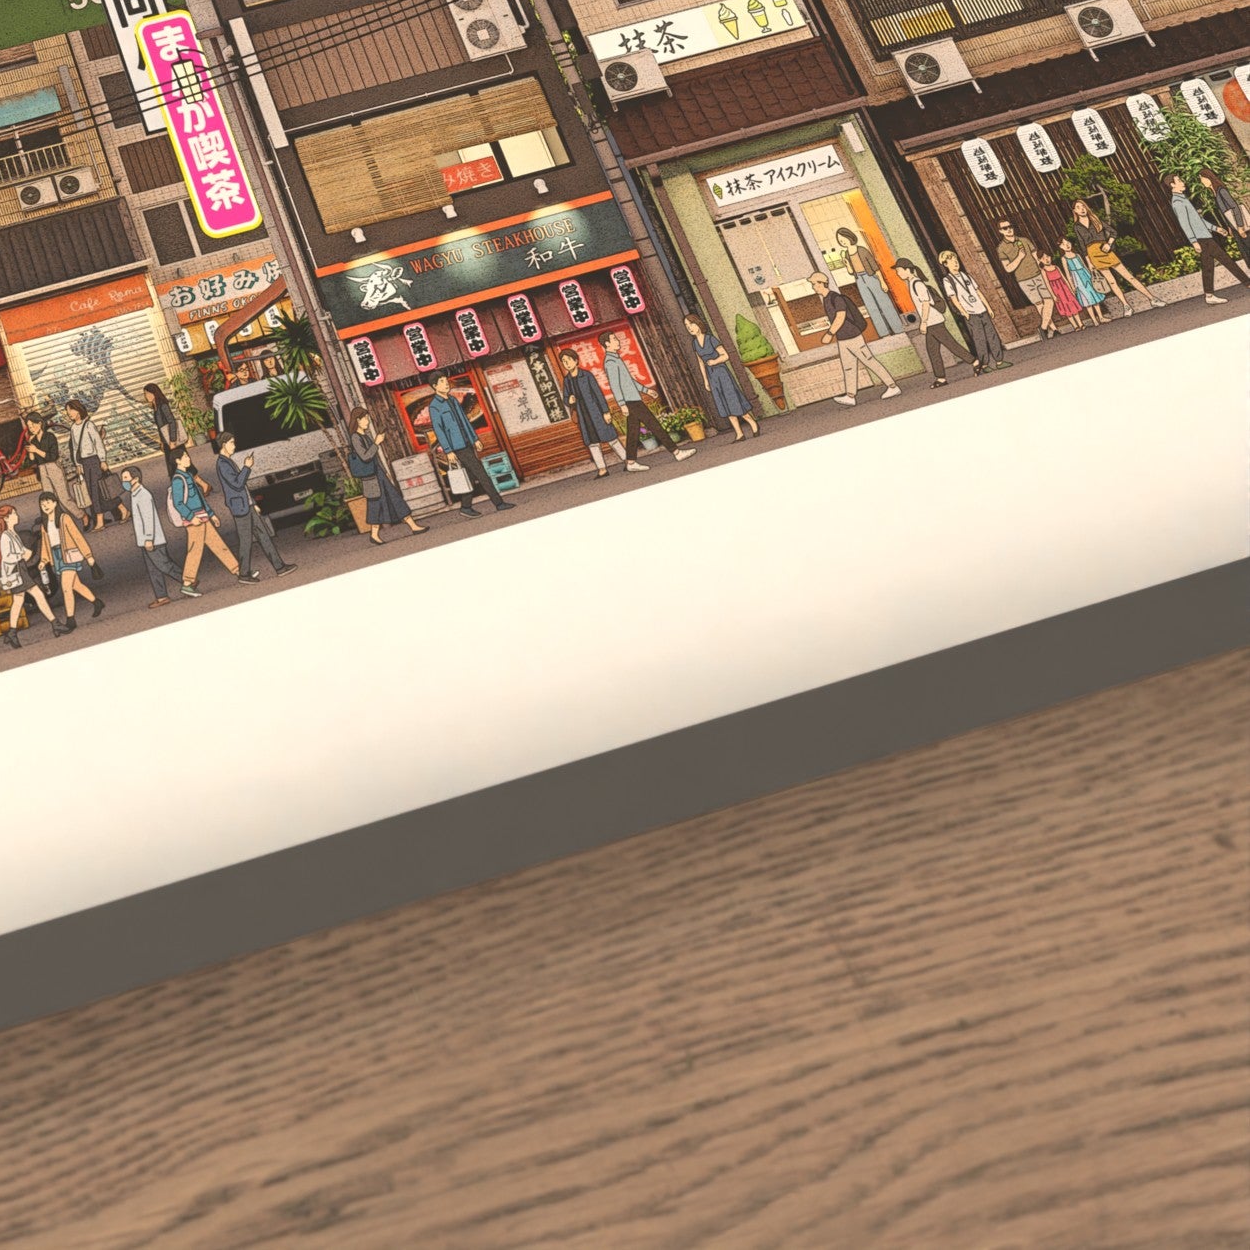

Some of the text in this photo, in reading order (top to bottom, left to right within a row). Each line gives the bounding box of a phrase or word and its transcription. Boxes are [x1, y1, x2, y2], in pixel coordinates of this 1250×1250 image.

[151, 25, 245, 212] まが喫茶
[763, 155, 840, 185] アイスクリーム
[410, 218, 576, 274] WAGYU STEAKHOUSE
[524, 236, 584, 270] 和牛
[70, 296, 102, 312] Cafe
